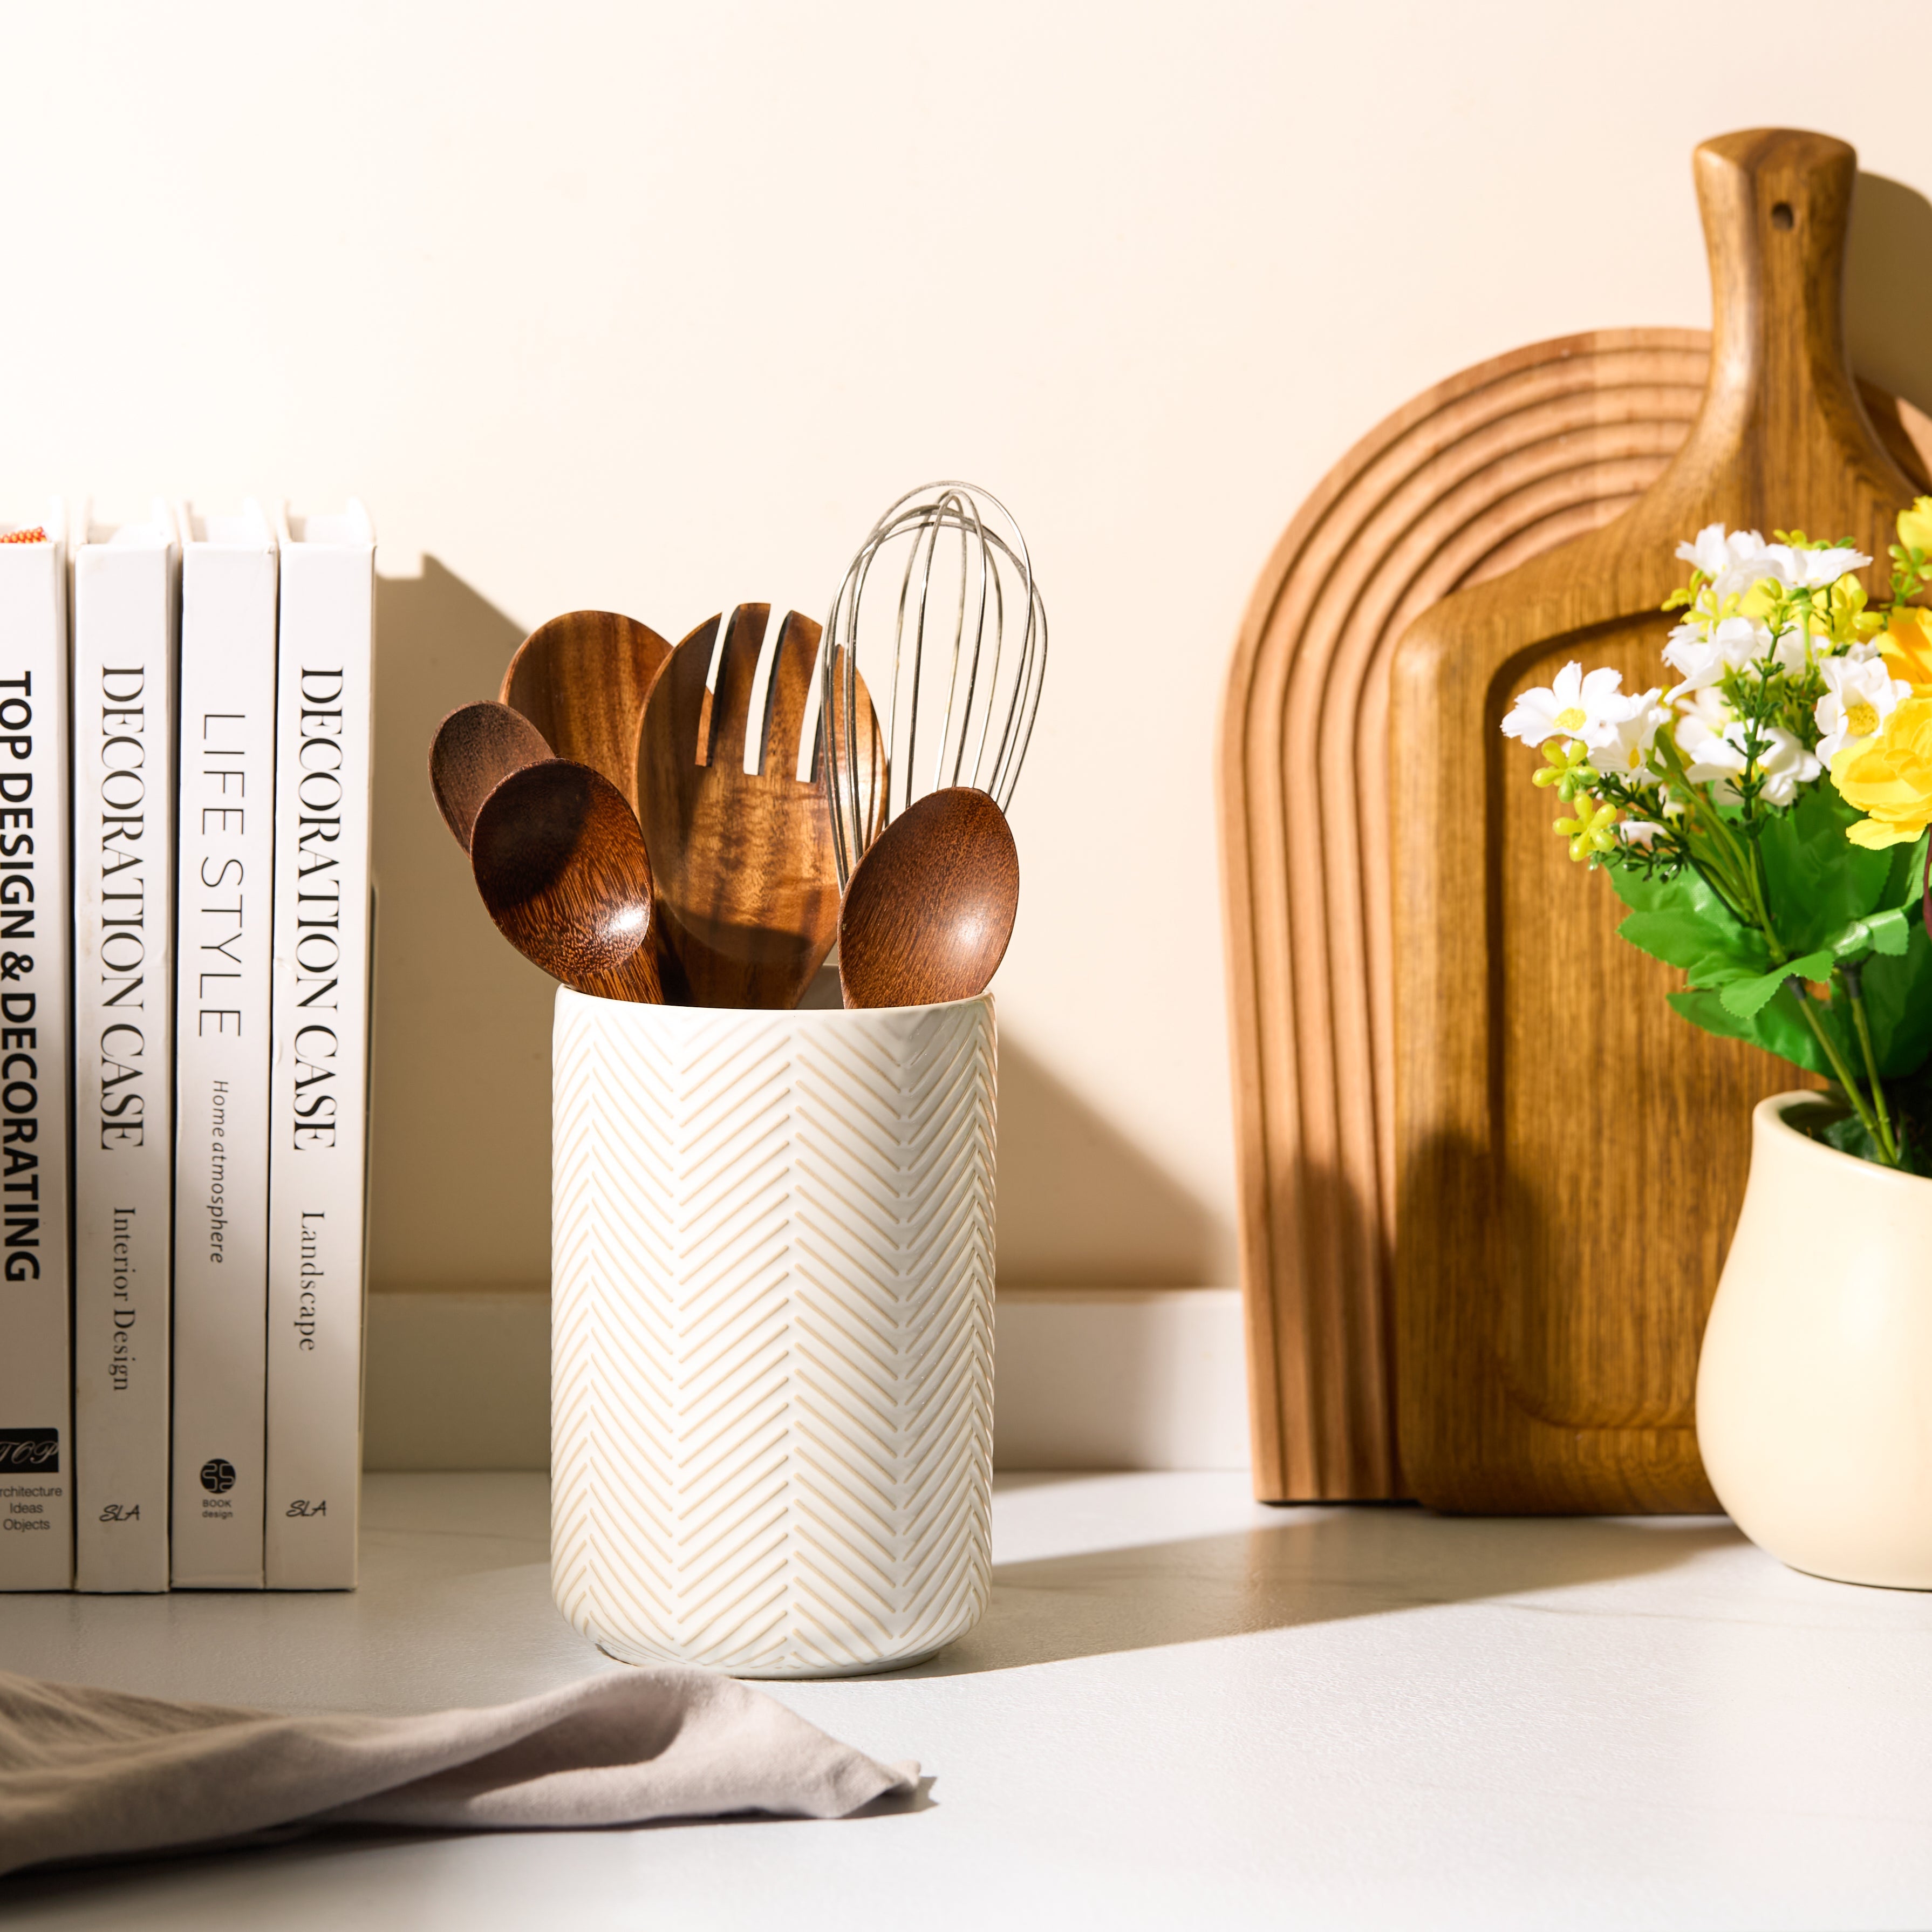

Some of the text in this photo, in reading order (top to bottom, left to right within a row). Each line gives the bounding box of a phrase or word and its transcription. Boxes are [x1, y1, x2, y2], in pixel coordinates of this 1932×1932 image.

[100, 664, 145, 1150] DECORATION CASE
[199, 714, 245, 1037] LIFE STYLE
[293, 666, 344, 1150] DECORATION CASE
[0, 671, 40, 1282] TOP DESIGN & DECORATING
[207, 1080, 229, 1264] Home atmosphere
[108, 1207, 136, 1391] Interior Design
[293, 1212, 325, 1350] Landscape
[3, 1518, 50, 1532] Objects
[10, 1503, 43, 1513] Ideas
[99, 1504, 140, 1523] SLA
[202, 1499, 231, 1507] BOOK
[202, 1510, 233, 1519] design
[286, 1500, 326, 1517] SLA
